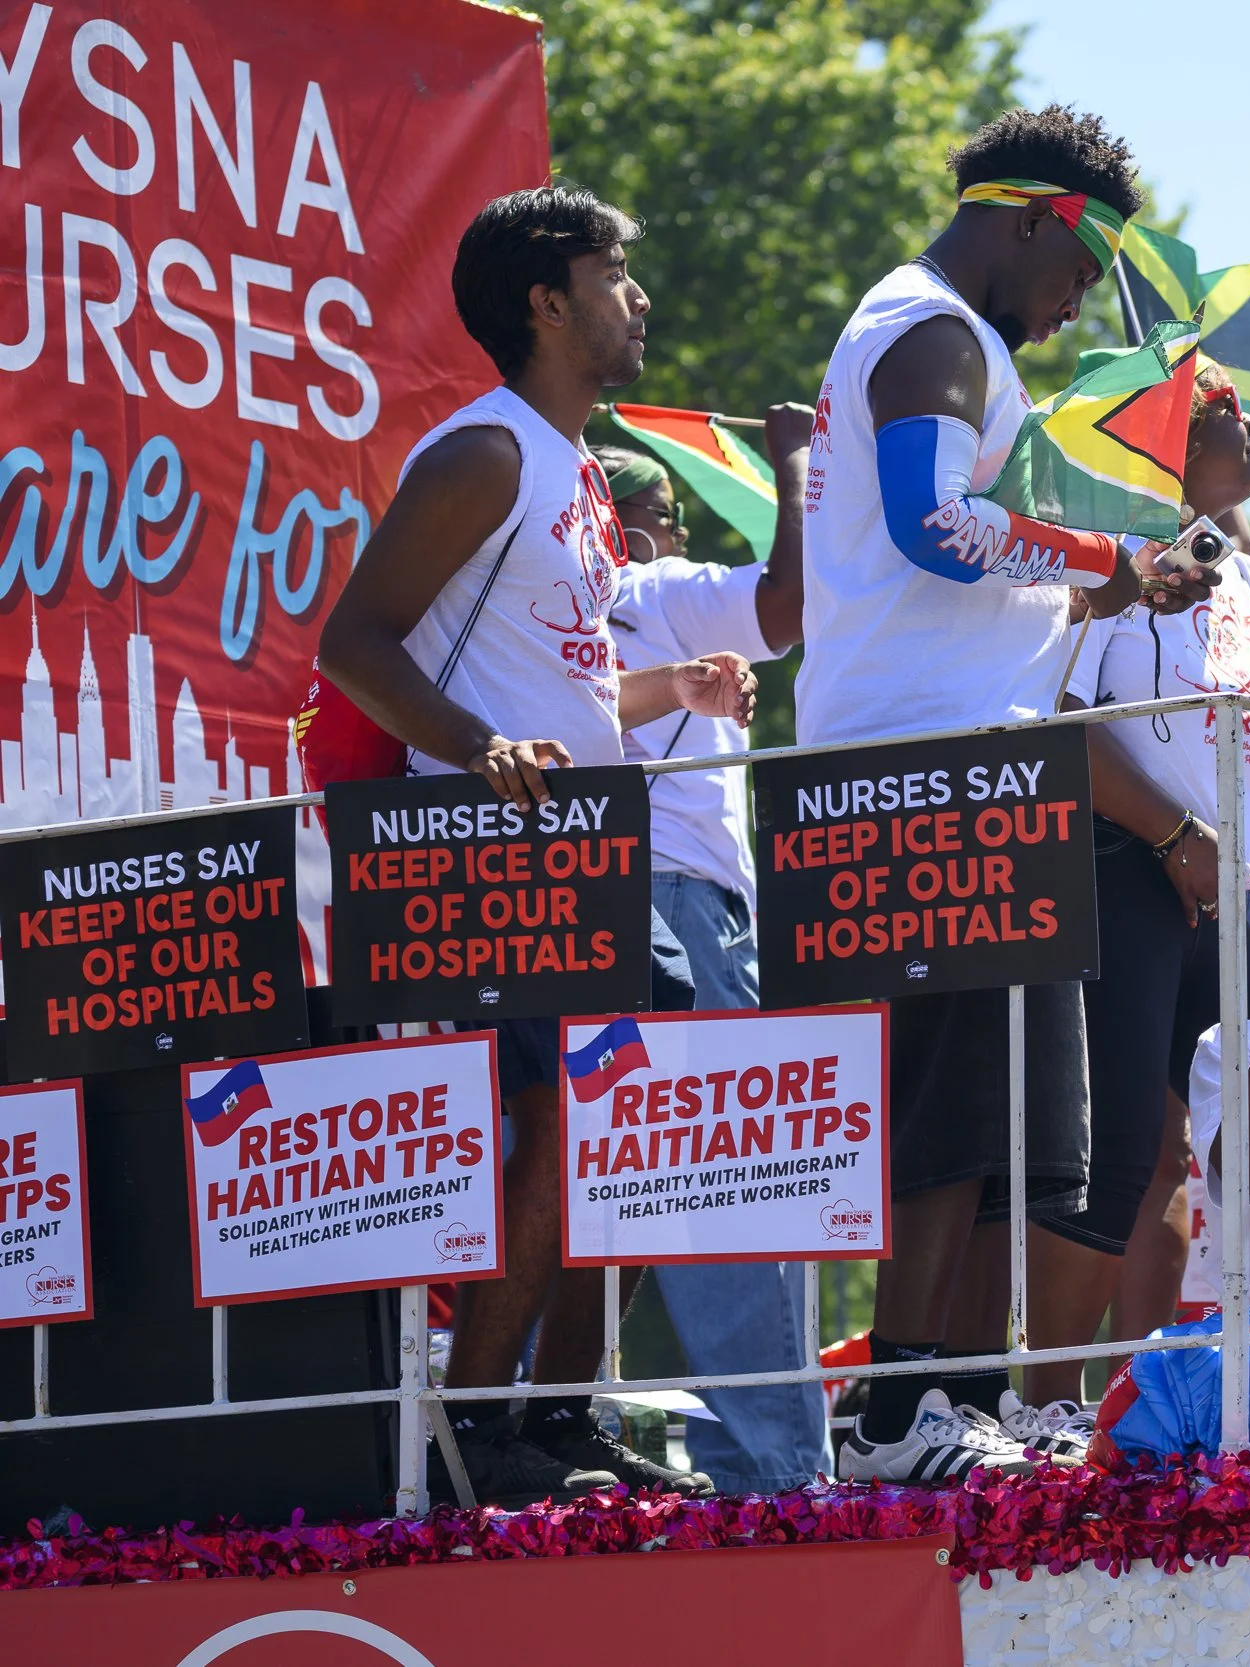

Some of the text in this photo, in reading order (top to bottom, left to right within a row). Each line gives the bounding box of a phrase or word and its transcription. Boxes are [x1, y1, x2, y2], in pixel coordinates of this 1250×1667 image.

[921, 499, 1066, 582] PANAMA
[798, 761, 1044, 822] NURSES SAY
[372, 797, 609, 845] NURSES SAY
[774, 801, 1077, 871] KEEP ICE OUT
[44, 841, 260, 901] NURSES SAY
[350, 837, 638, 891] KEEP ICE OUT
[829, 855, 1014, 910] OF OUR
[20, 878, 285, 948] KEEP ICE OUT
[405, 887, 578, 933] OF OUR
[796, 898, 1058, 962] HOSPITALS
[83, 932, 240, 985] OF OUR
[371, 931, 615, 981] HOSPITALS
[47, 971, 275, 1035] HOSPITALS
[610, 1055, 839, 1129] RESTORE
[239, 1084, 448, 1170] RESTORE
[576, 1103, 870, 1179] HAITIAN TPS
[207, 1128, 482, 1221] HAITIAN TPS
[587, 1151, 859, 1202] SOLIDARITY WITH IMMIGRANT
[619, 1178, 830, 1220] HEALTHCARE WORKERS
[2, 1221, 60, 1245] GRANT
[218, 1176, 472, 1243] SOLIDARITY WITH IMMIGRANT
[249, 1203, 444, 1258] HEALTHCARE WORKERS
[830, 1213, 872, 1225] NURSES
[444, 1235, 486, 1248] NURSES
[36, 1278, 75, 1291] NURSES
